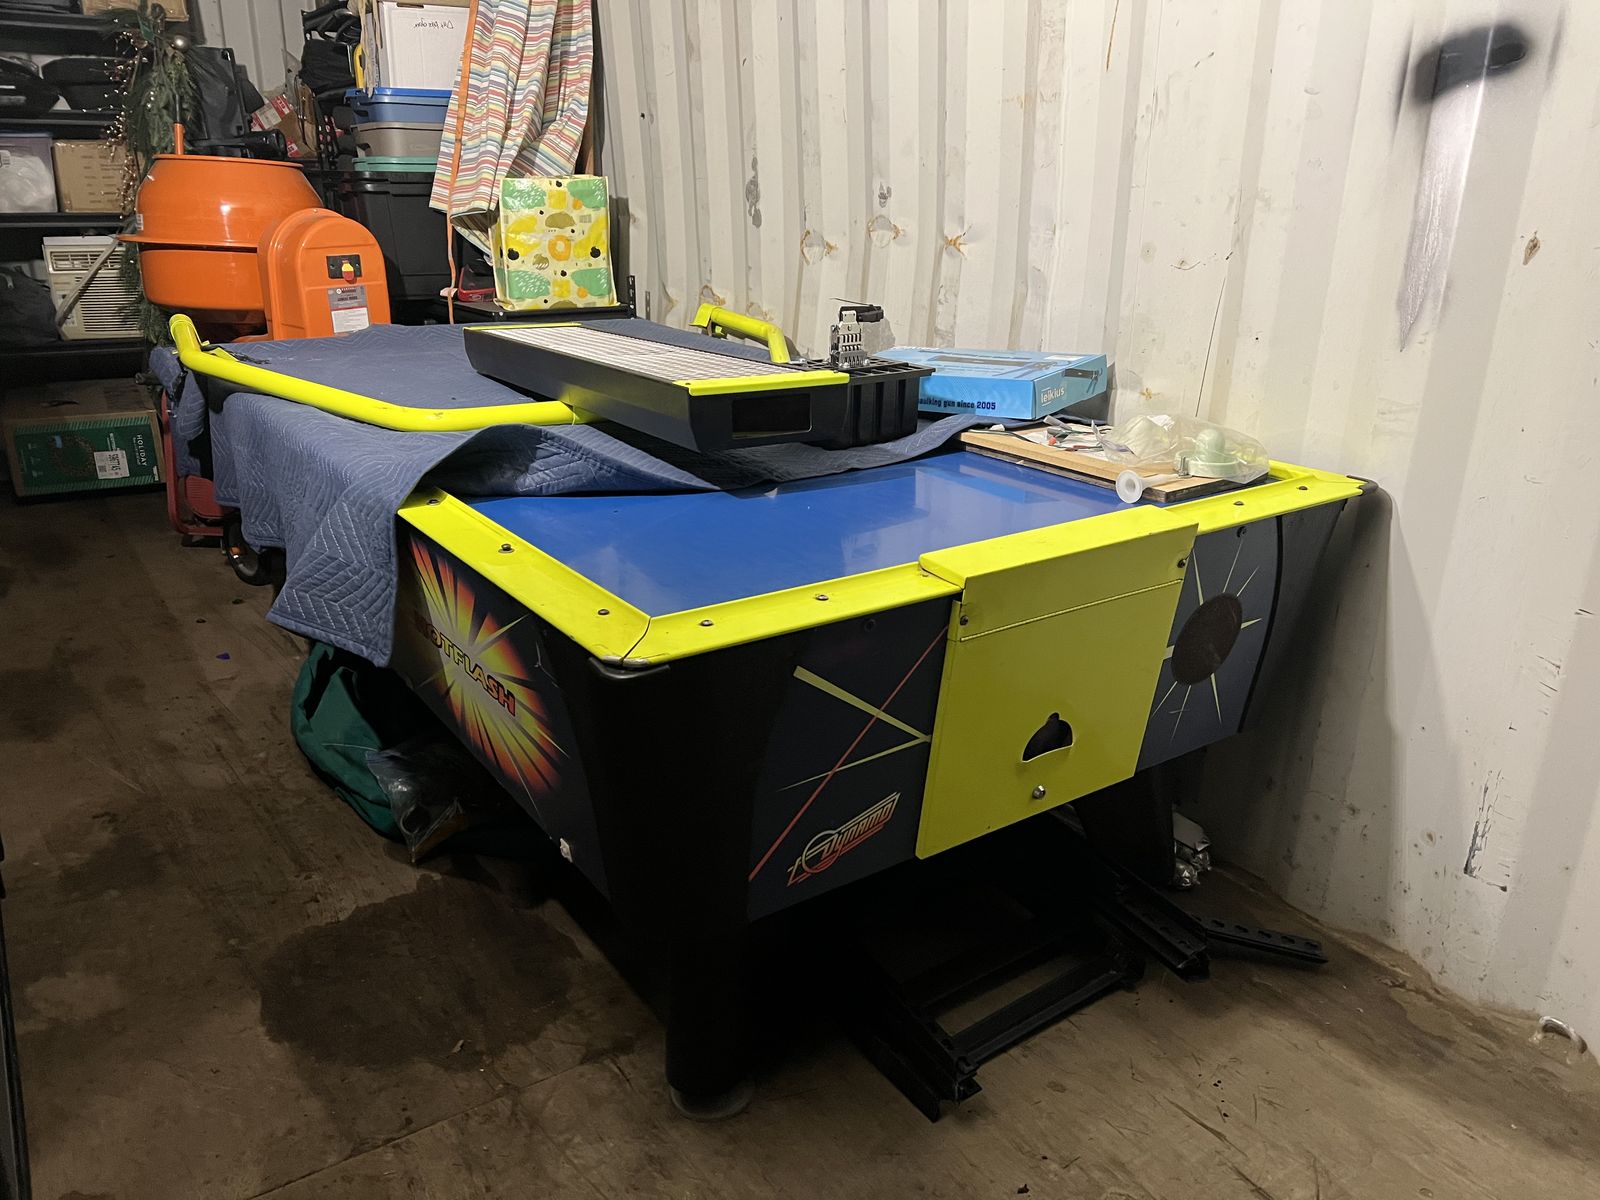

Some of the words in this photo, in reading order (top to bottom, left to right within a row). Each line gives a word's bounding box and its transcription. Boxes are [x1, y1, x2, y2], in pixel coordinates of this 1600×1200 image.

[918, 397, 941, 407] aulking
[944, 400, 955, 408] gun
[957, 400, 975, 408] since
[976, 401, 996, 410] 2005
[136, 434, 147, 466] HOLIDAY
